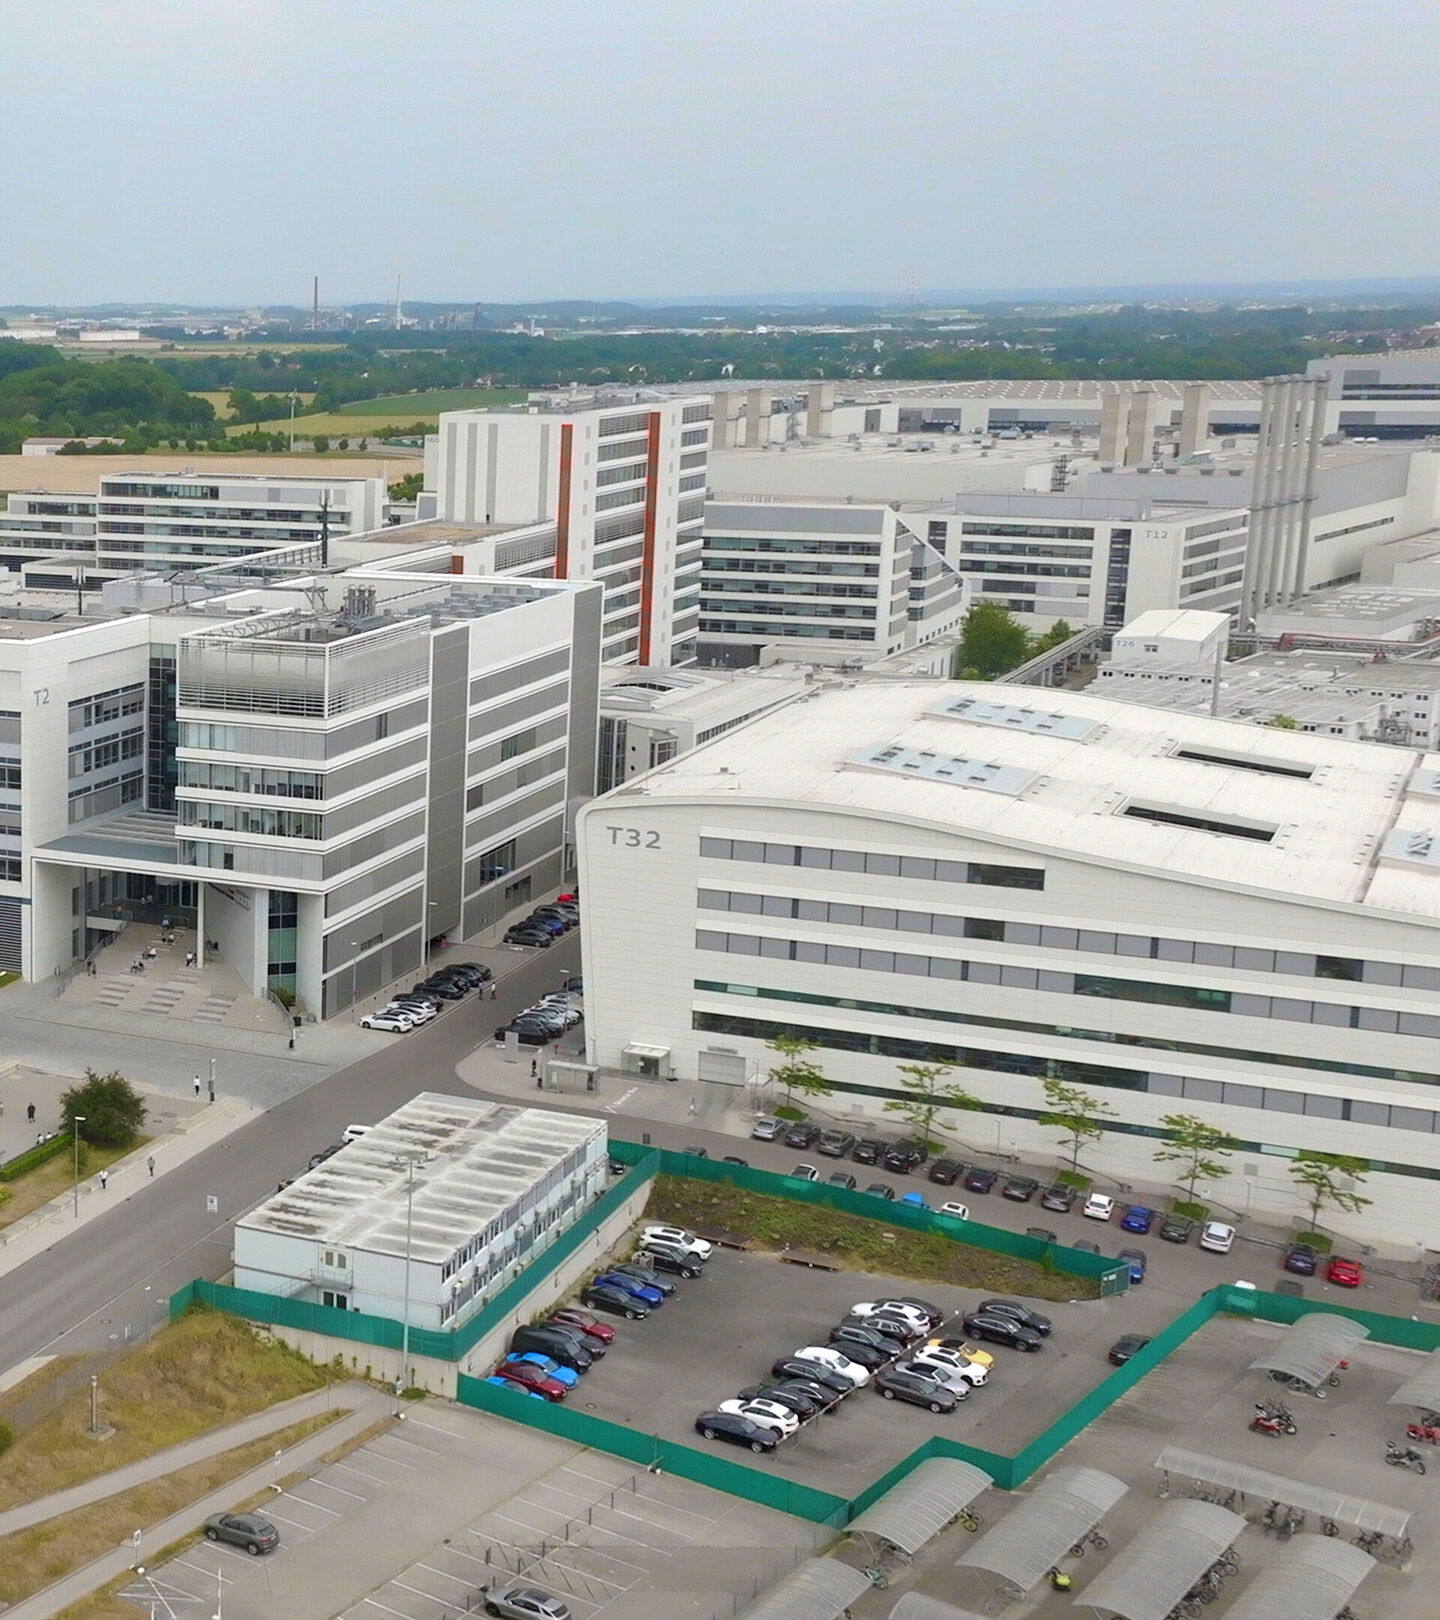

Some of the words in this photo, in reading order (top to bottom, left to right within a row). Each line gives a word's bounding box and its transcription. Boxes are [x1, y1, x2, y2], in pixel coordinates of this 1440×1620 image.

[1145, 530, 1168, 539] T12
[33, 688, 50, 707] T2
[606, 826, 662, 850] T32
